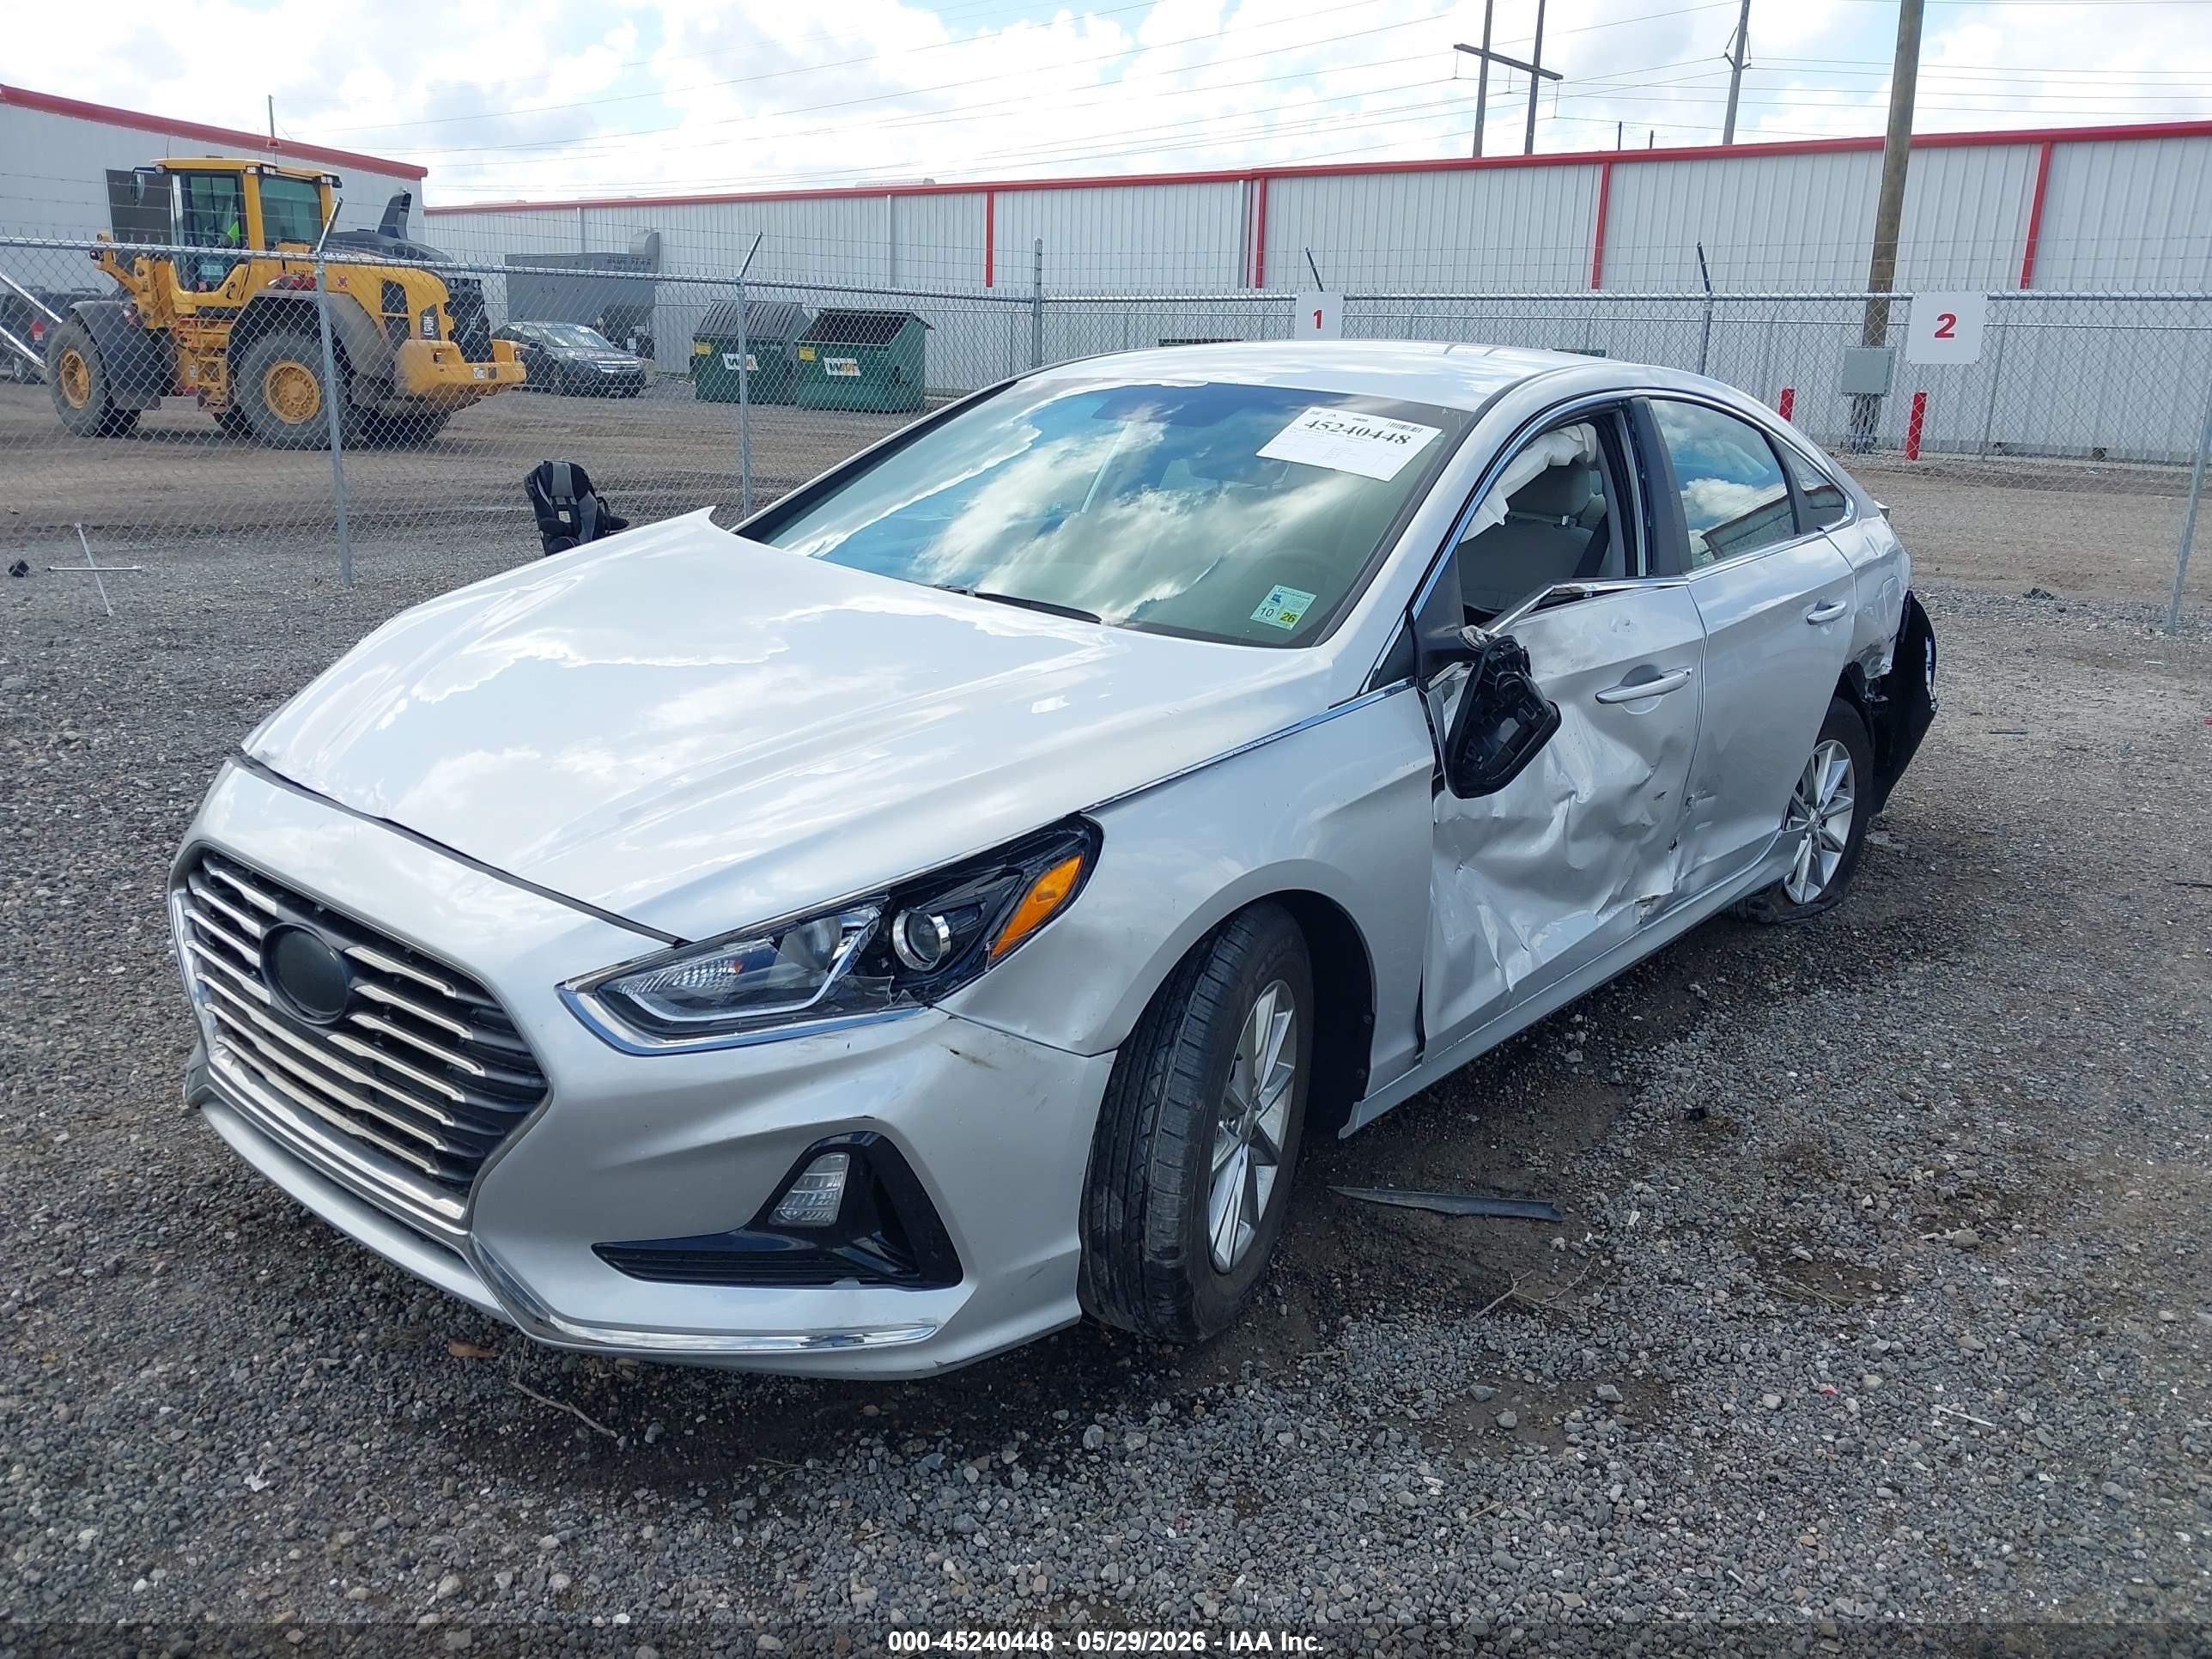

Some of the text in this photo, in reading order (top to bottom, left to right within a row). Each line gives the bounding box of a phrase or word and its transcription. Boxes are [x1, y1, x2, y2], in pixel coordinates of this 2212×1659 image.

[1313, 309, 1322, 330] 1
[1934, 313, 1956, 338] 2
[1304, 419, 1412, 445] 45240448
[1260, 607, 1297, 623] 10 26
